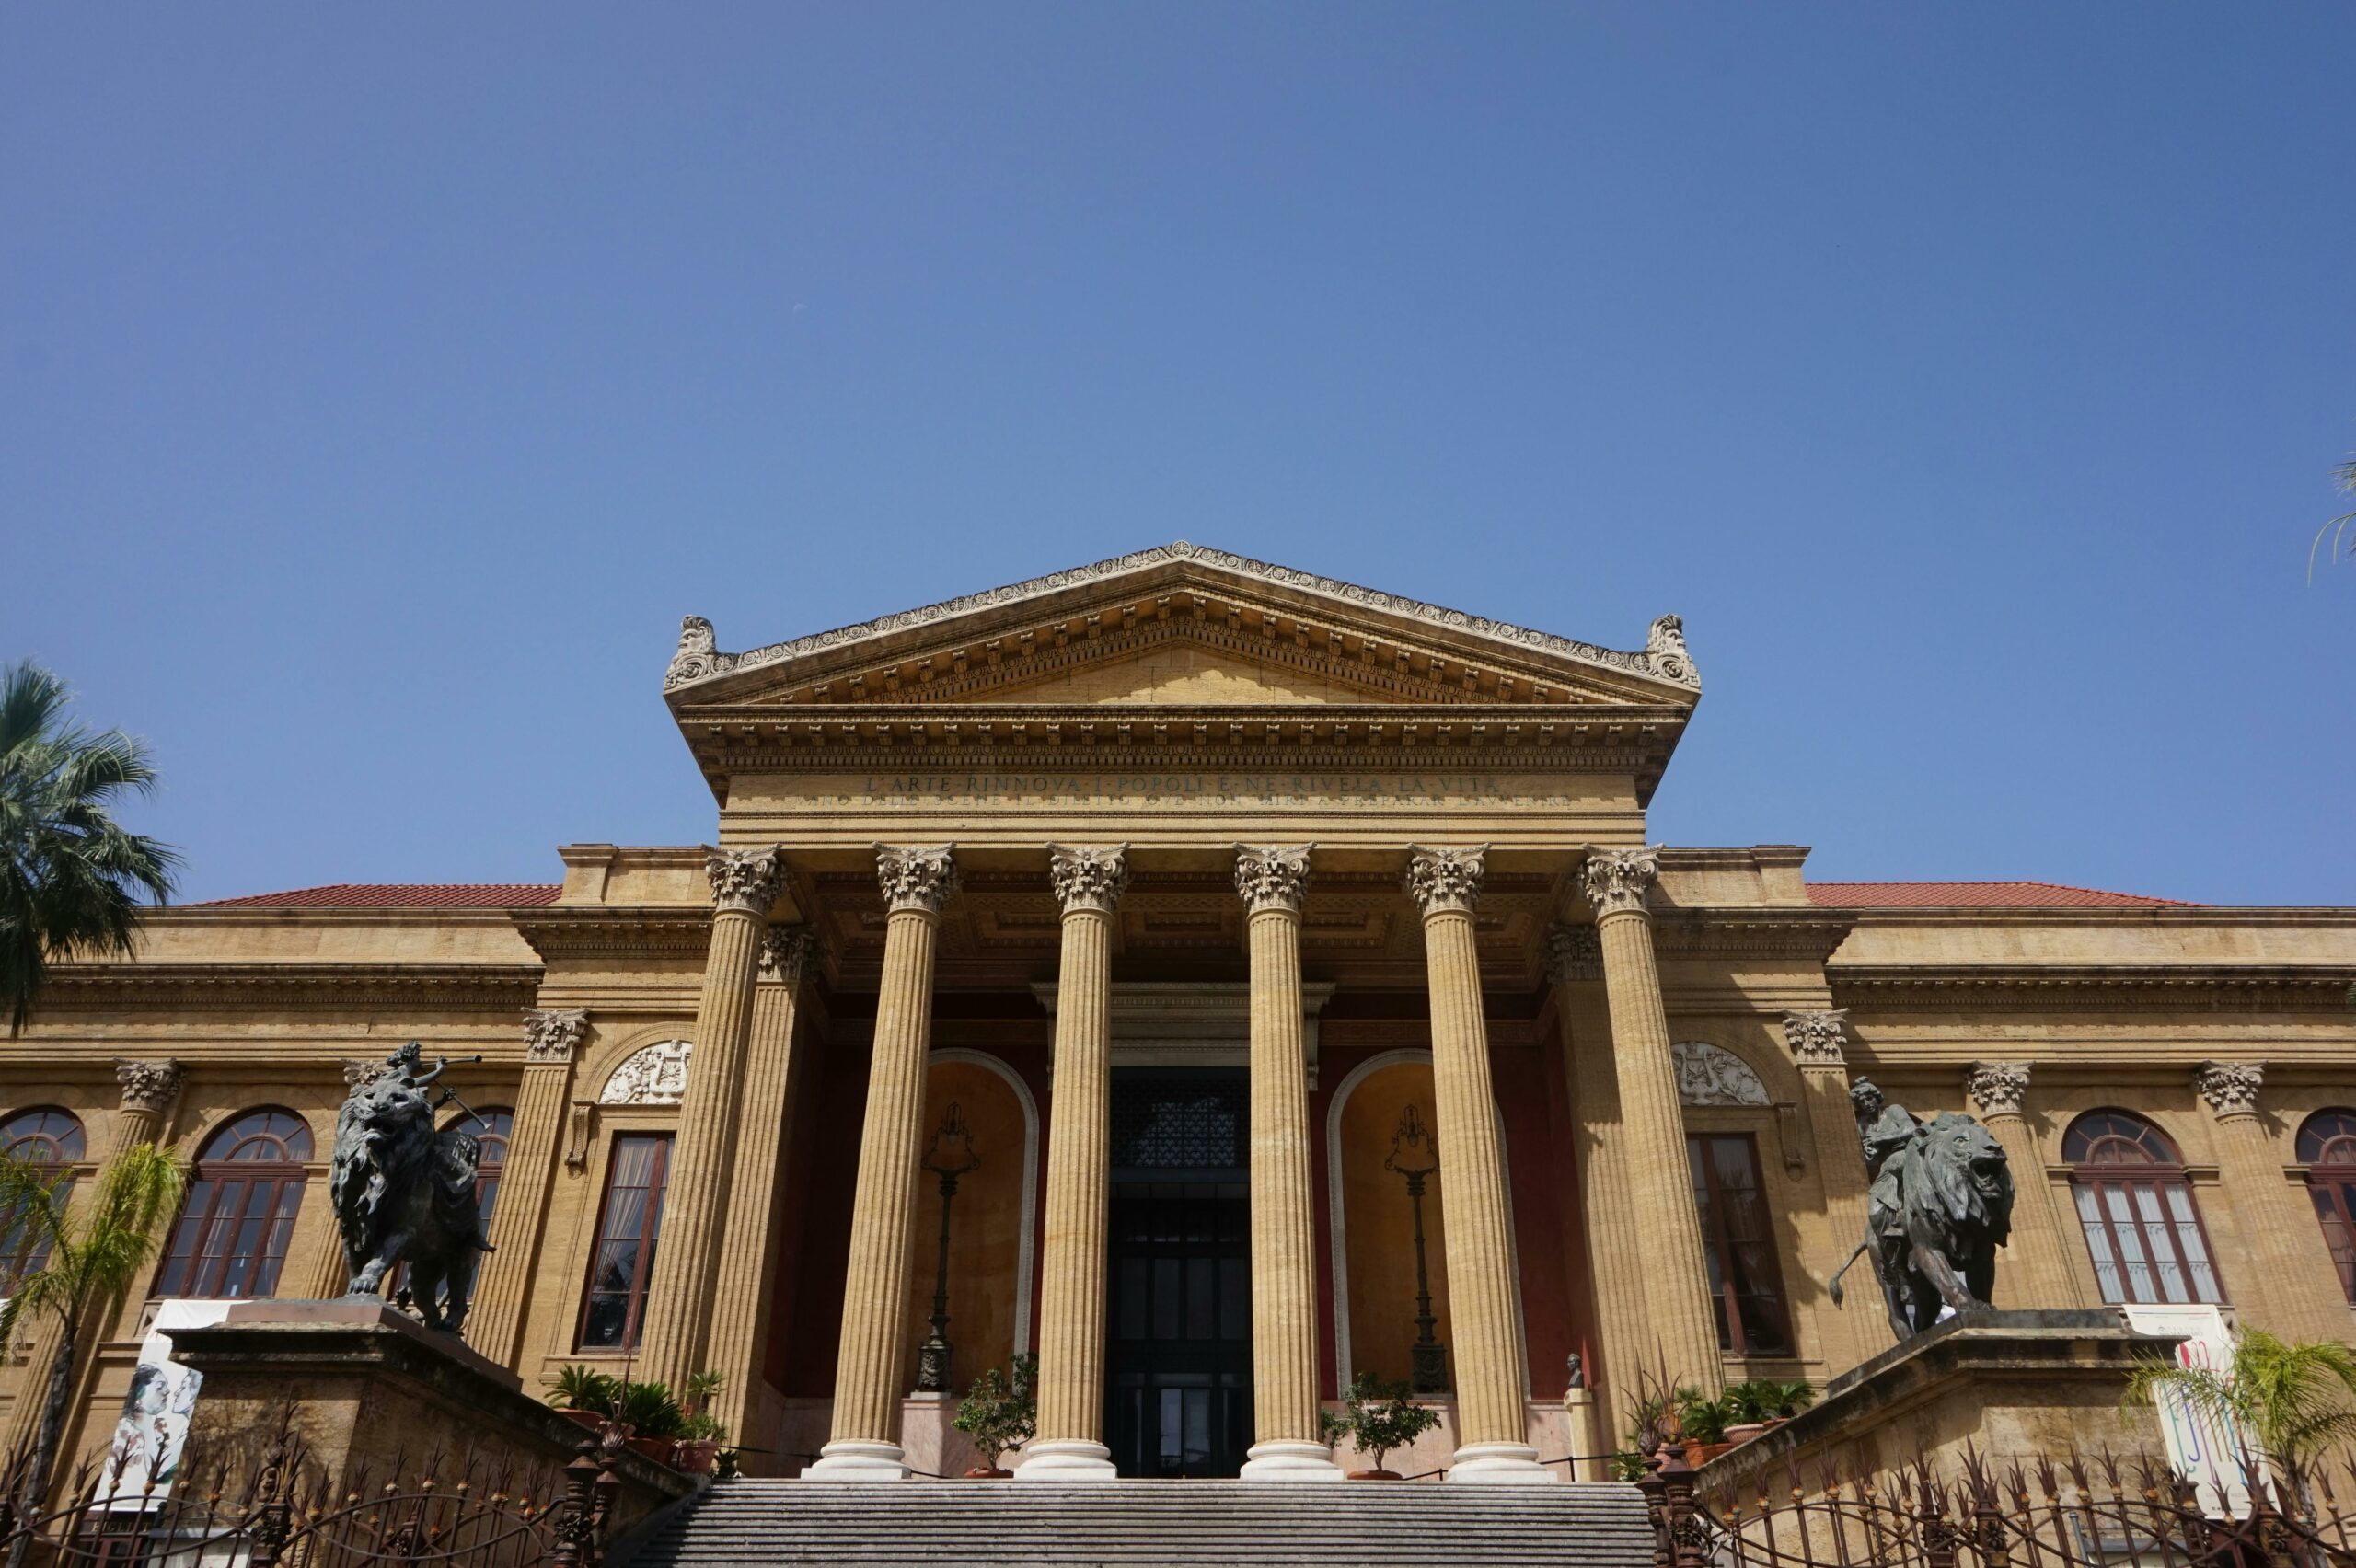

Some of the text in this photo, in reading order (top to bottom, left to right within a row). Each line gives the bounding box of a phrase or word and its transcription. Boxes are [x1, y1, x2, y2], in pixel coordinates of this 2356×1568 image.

[966, 777, 1081, 792] RINNOVA
[1094, 777, 1102, 792] I
[1117, 777, 1202, 792] POPOLI
[1218, 777, 1230, 792] E
[1245, 777, 1276, 792] NE
[1292, 777, 1383, 792] RIVELA
[1399, 777, 1426, 792] LA
[1437, 777, 1499, 792] VITA
[861, 795, 918, 806] DELLE
[1317, 795, 1331, 806] A
